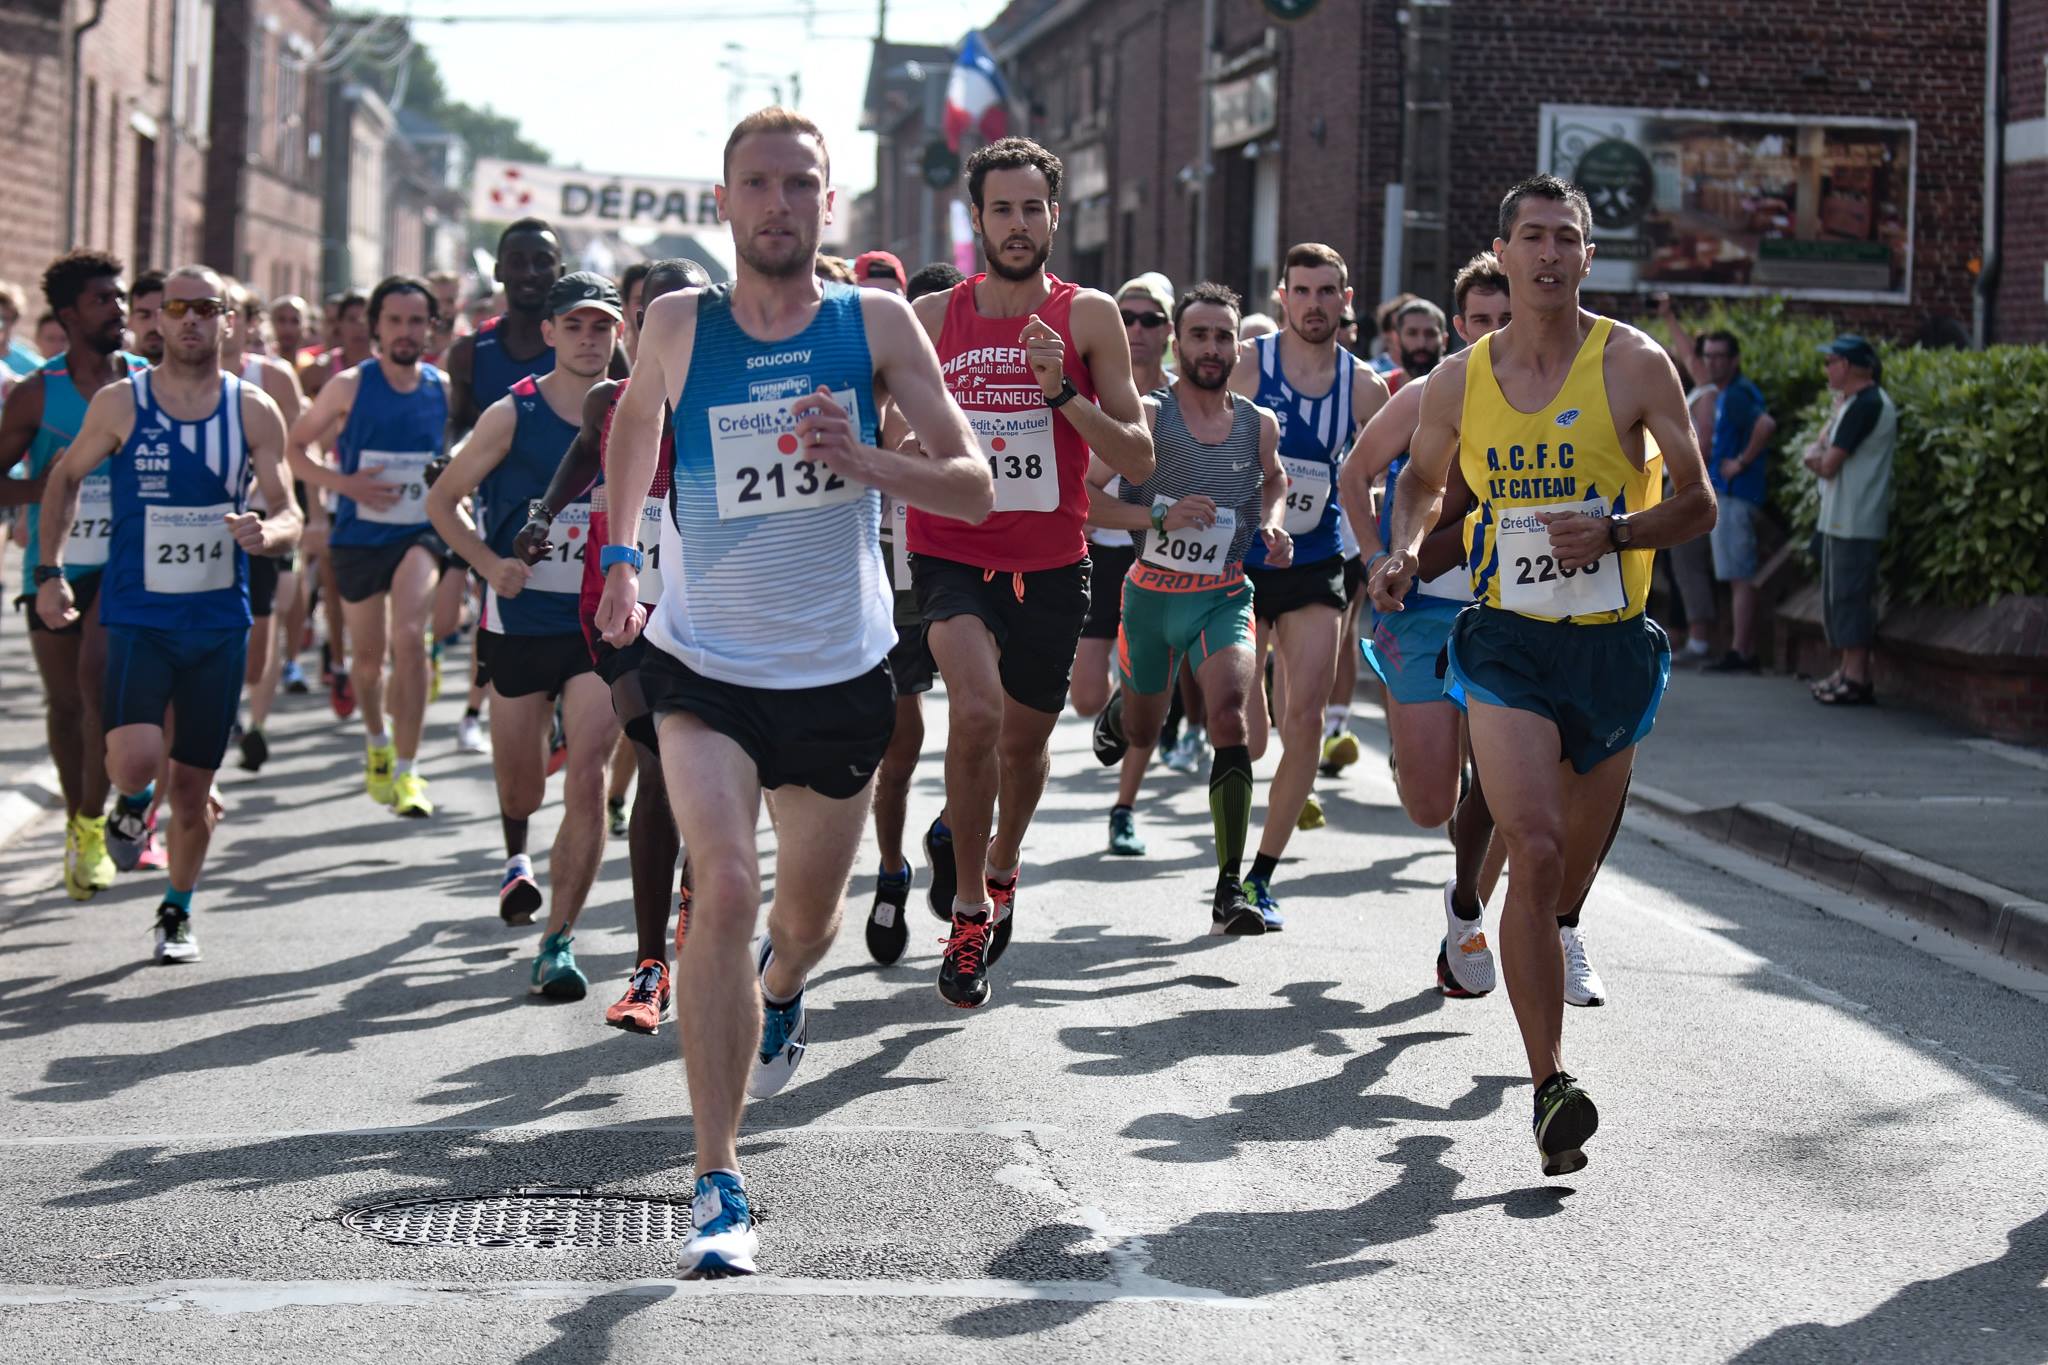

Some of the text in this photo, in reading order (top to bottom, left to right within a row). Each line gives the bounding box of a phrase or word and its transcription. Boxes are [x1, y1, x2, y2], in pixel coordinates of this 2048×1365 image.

[746, 349, 812, 369] saucony
[969, 363, 1027, 374] multi athlon
[718, 412, 771, 432] Crédit
[758, 427, 778, 435] Nord
[1006, 416, 1048, 431] Mutuel
[134, 442, 169, 457] A.S
[1486, 443, 1574, 471] A.C.F.C
[134, 458, 170, 472] SIN
[988, 454, 1043, 479] 138
[736, 460, 845, 503] 2132
[1489, 476, 1576, 499] LE CATEAU
[1286, 492, 1314, 512] 45
[1501, 515, 1541, 529] Crédit
[157, 540, 223, 564] 2314
[1155, 537, 1218, 563] 2094
[1140, 571, 1194, 589] PRO
